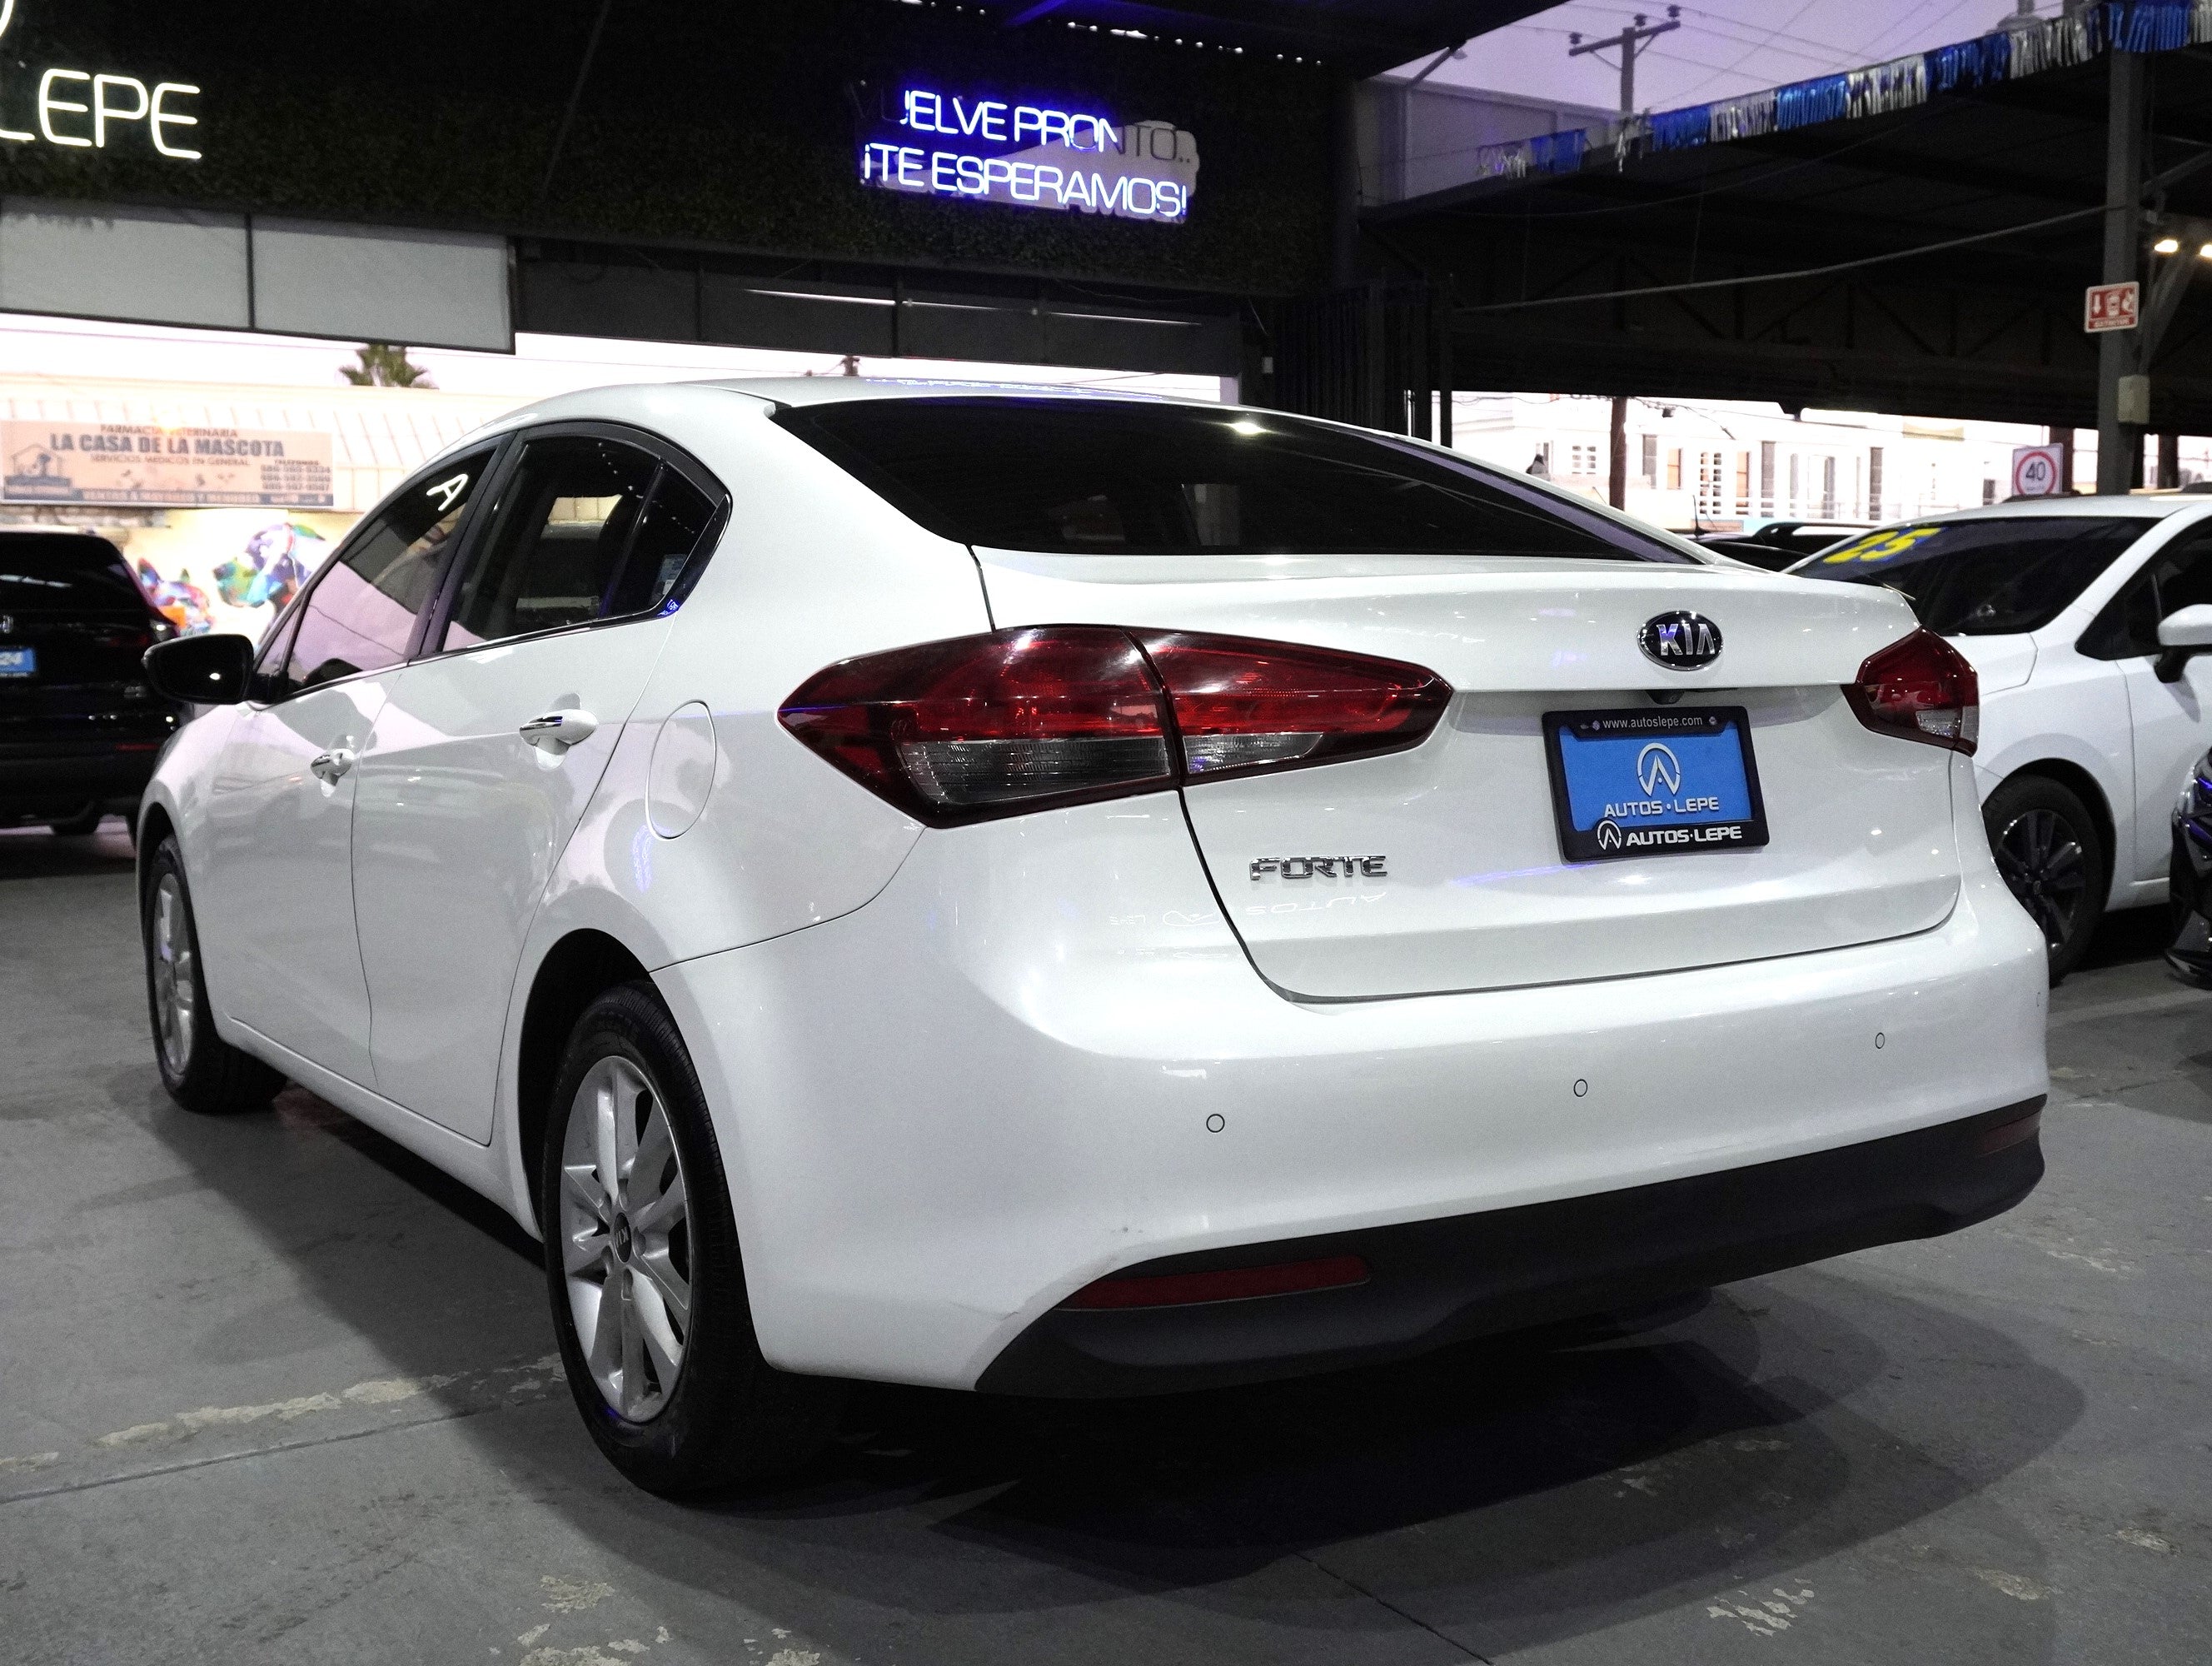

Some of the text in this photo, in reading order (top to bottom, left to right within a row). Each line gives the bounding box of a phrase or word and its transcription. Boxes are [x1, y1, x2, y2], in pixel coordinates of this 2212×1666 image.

[932, 152, 1188, 218] ESPERAMOS!
[49, 432, 285, 456] LA CASA DE LA MASCOTA
[169, 426, 238, 438] TERINARIA
[2025, 461, 2046, 481] 40
[1656, 622, 1716, 656] KIA
[1602, 716, 1703, 730] www.autoslepe.com
[1249, 855, 1388, 880] FORTE
